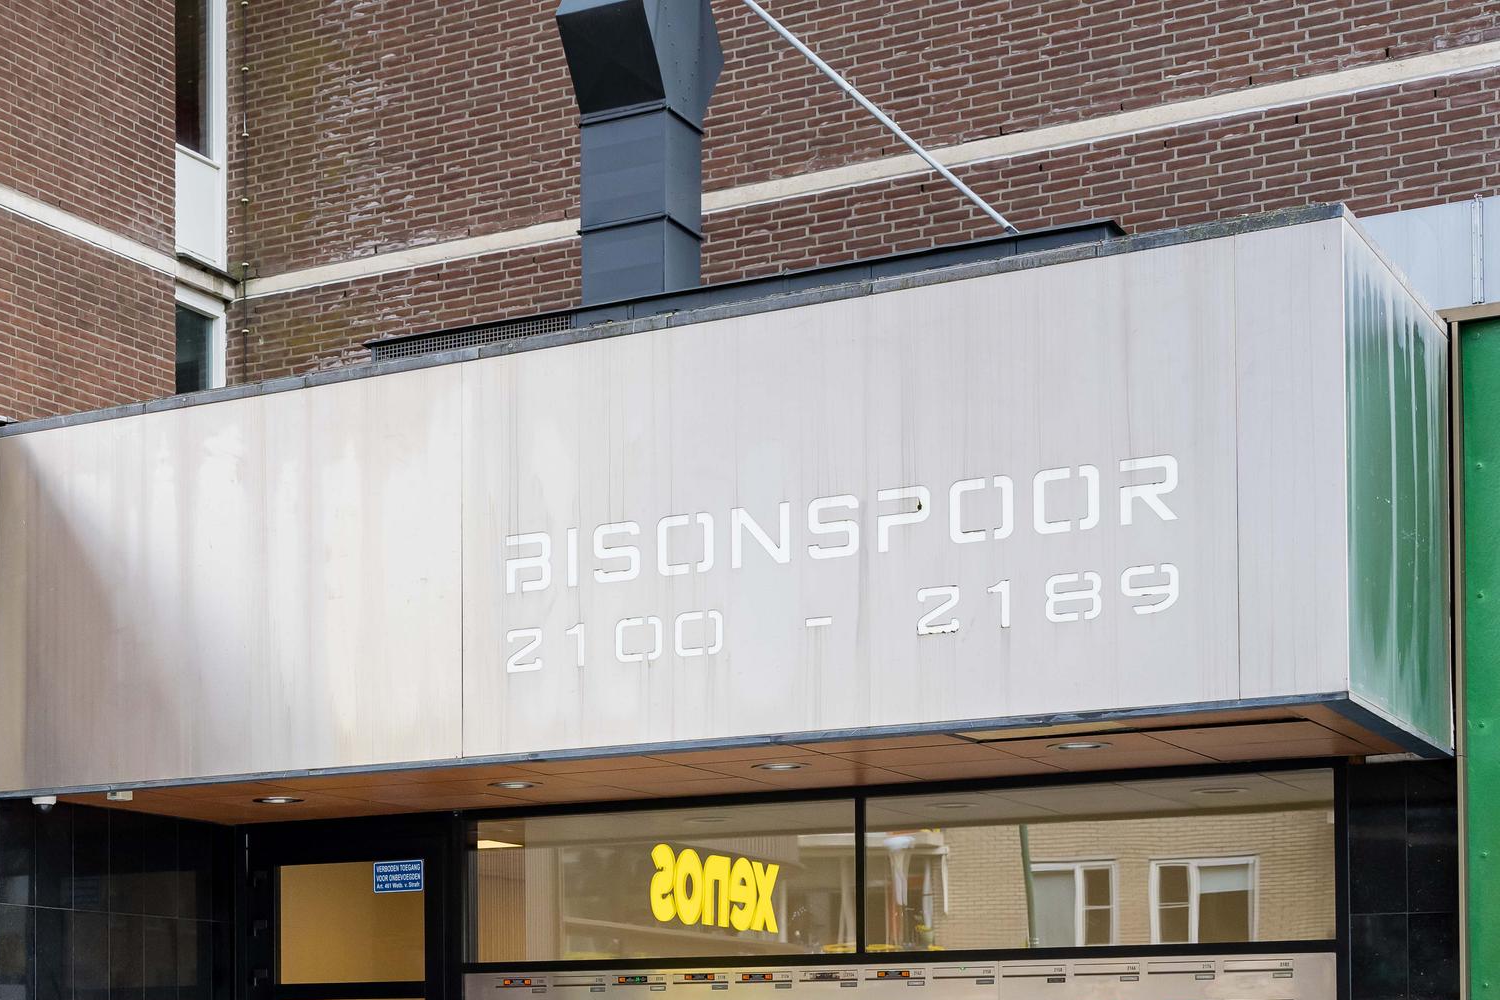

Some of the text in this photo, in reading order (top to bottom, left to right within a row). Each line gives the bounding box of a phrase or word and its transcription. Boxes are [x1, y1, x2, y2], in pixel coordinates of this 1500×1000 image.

[505, 454, 1179, 594] BISONSPOOR
[506, 562, 1180, 674] 2100 - 2189
[400, 863, 420, 871] TOEGANG
